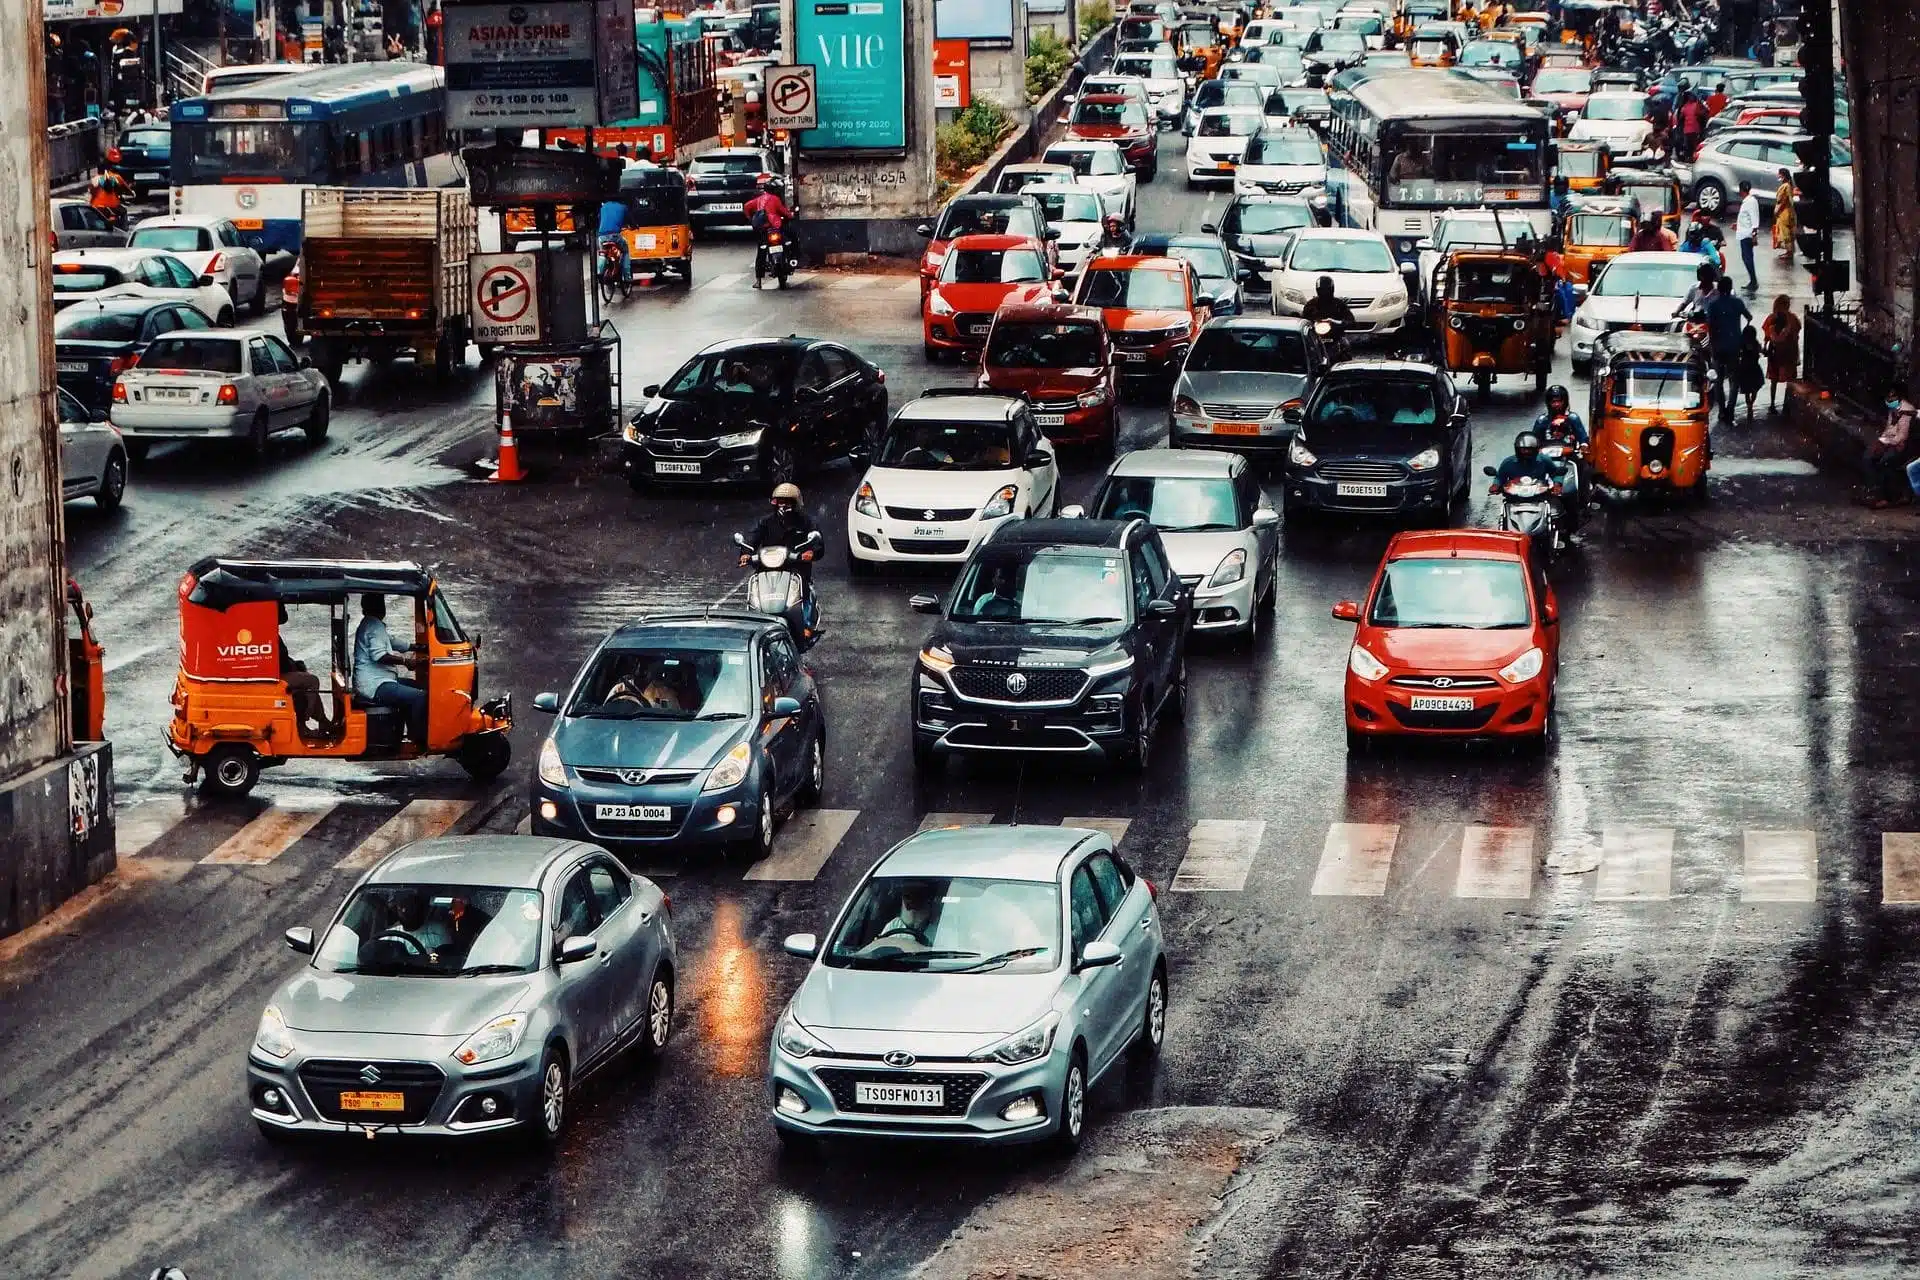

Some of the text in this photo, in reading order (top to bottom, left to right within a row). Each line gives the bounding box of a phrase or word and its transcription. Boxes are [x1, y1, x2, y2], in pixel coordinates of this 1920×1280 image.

[468, 23, 571, 40] ASIAN SPINE
[817, 33, 885, 69] vue
[489, 95, 504, 104] 72
[507, 95, 528, 104] 108
[548, 93, 569, 103] 108
[780, 116, 796, 124] RIGHT
[831, 121, 853, 129] 9090
[855, 121, 867, 129] 59
[869, 120, 890, 129] 2020
[478, 324, 536, 337] NO RIGHT TURN
[1342, 485, 1386, 494] TS03ET5151
[217, 645, 272, 655] VIRGO
[1413, 698, 1473, 710] AP09CB4433
[601, 808, 665, 818] AP 23 AD 0004
[864, 1087, 941, 1103] TS09FN0131
[343, 1099, 360, 1108] TS09
